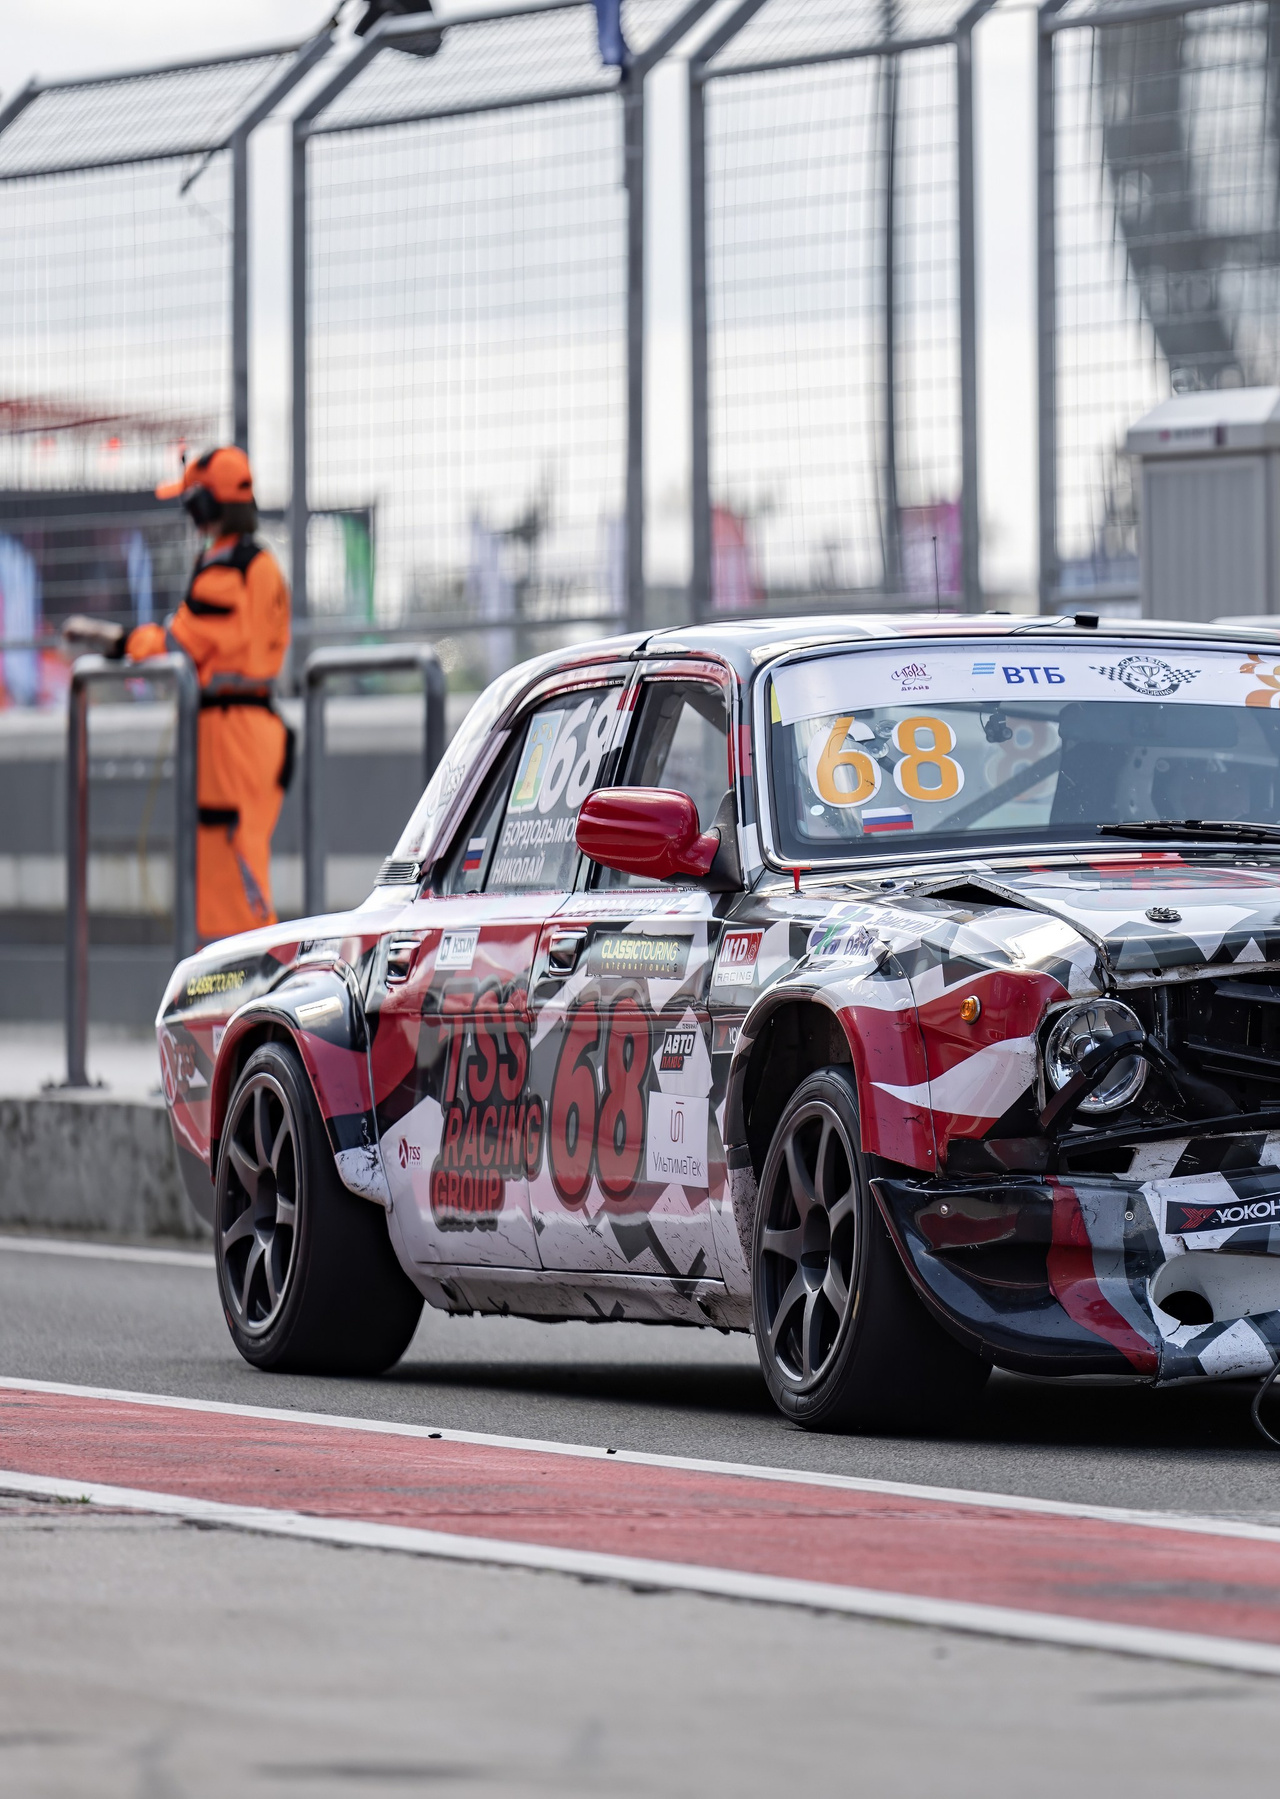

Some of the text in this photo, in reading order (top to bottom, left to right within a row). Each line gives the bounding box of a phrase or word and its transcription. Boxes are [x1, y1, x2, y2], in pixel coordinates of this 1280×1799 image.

[1002, 667, 1065, 684] ВТБ
[538, 690, 621, 814] 68
[808, 716, 964, 808] 68
[503, 817, 577, 850] БОРДОДЫМО
[492, 851, 546, 884] НИКОЛАЙ
[601, 940, 679, 961] CLASSICTOURING
[721, 937, 748, 963] M1D
[601, 962, 670, 973] INTERNATIONAL
[717, 971, 752, 983] RACING
[441, 989, 529, 1103] TSS
[664, 1034, 694, 1054] АВТО
[661, 1055, 683, 1068] ПЛЮС
[549, 997, 651, 1200] 68
[443, 1103, 542, 1168] RACING
[409, 1146, 421, 1160] TSS
[433, 1168, 500, 1217] GROUP
